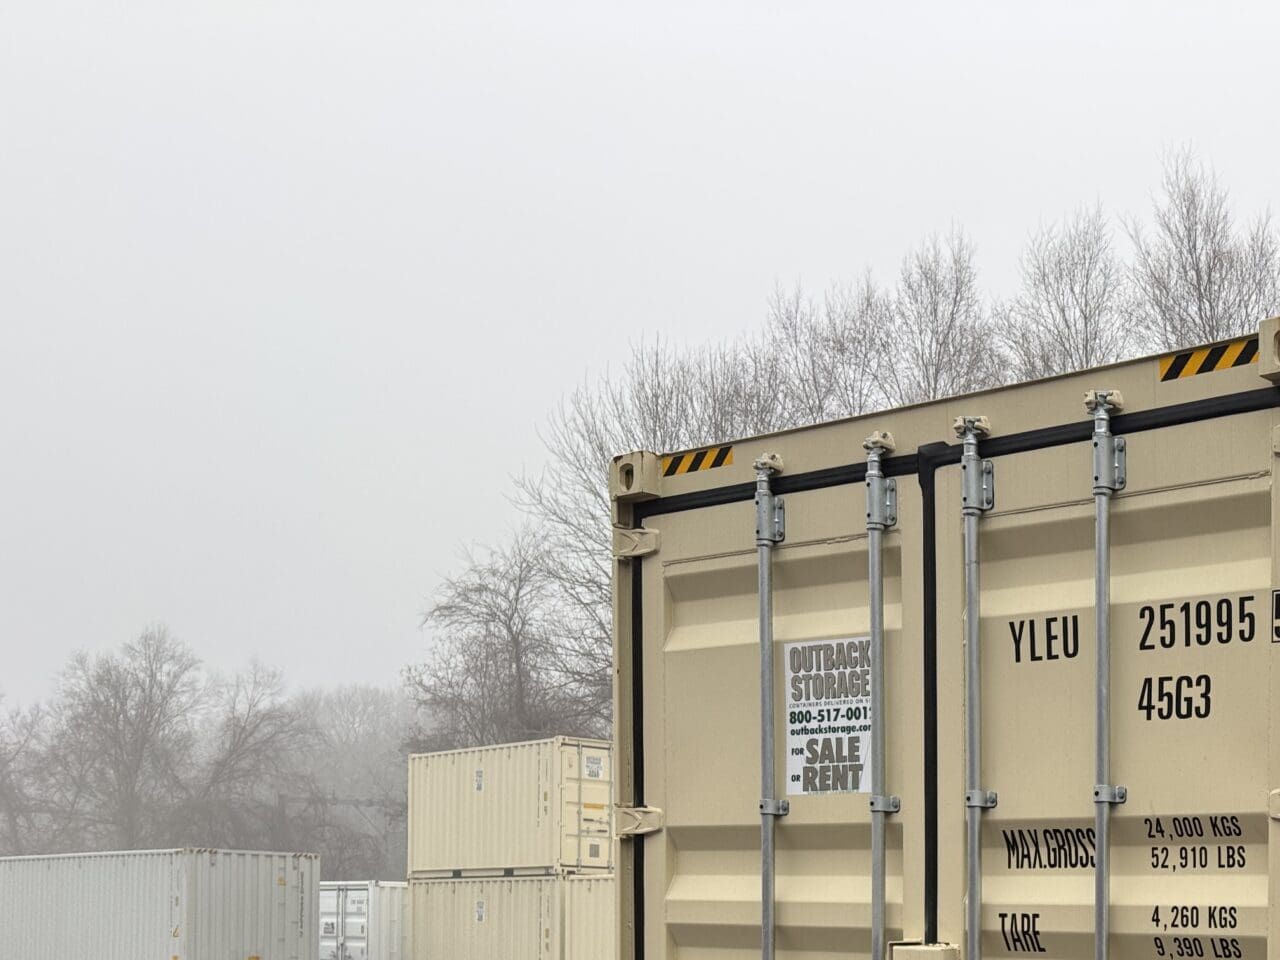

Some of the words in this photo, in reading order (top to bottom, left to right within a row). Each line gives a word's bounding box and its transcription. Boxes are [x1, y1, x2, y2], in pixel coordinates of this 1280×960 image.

[1008, 614, 1079, 663] YLEU
[1139, 595, 1256, 651] 251995
[789, 640, 871, 674] OUTBACK
[791, 669, 870, 701] STORAGE
[1137, 674, 1212, 721] 45G3
[789, 701, 822, 709] CONTAINERS
[824, 698, 854, 706] DELIVERED
[791, 748, 804, 756] FOR
[805, 736, 860, 765] SALE
[791, 774, 801, 783] OR
[802, 763, 864, 792] RENT
[1144, 816, 1203, 841] 24,000
[1209, 815, 1242, 838] KGS
[1151, 846, 1208, 872] 52,910
[1217, 845, 1246, 869] LBS
[998, 912, 1047, 953] TARE
[1151, 905, 1199, 931] 4,260
[1208, 906, 1238, 929] KGS
[1153, 937, 1204, 960] 9,390
[1210, 937, 1242, 959] LBS
